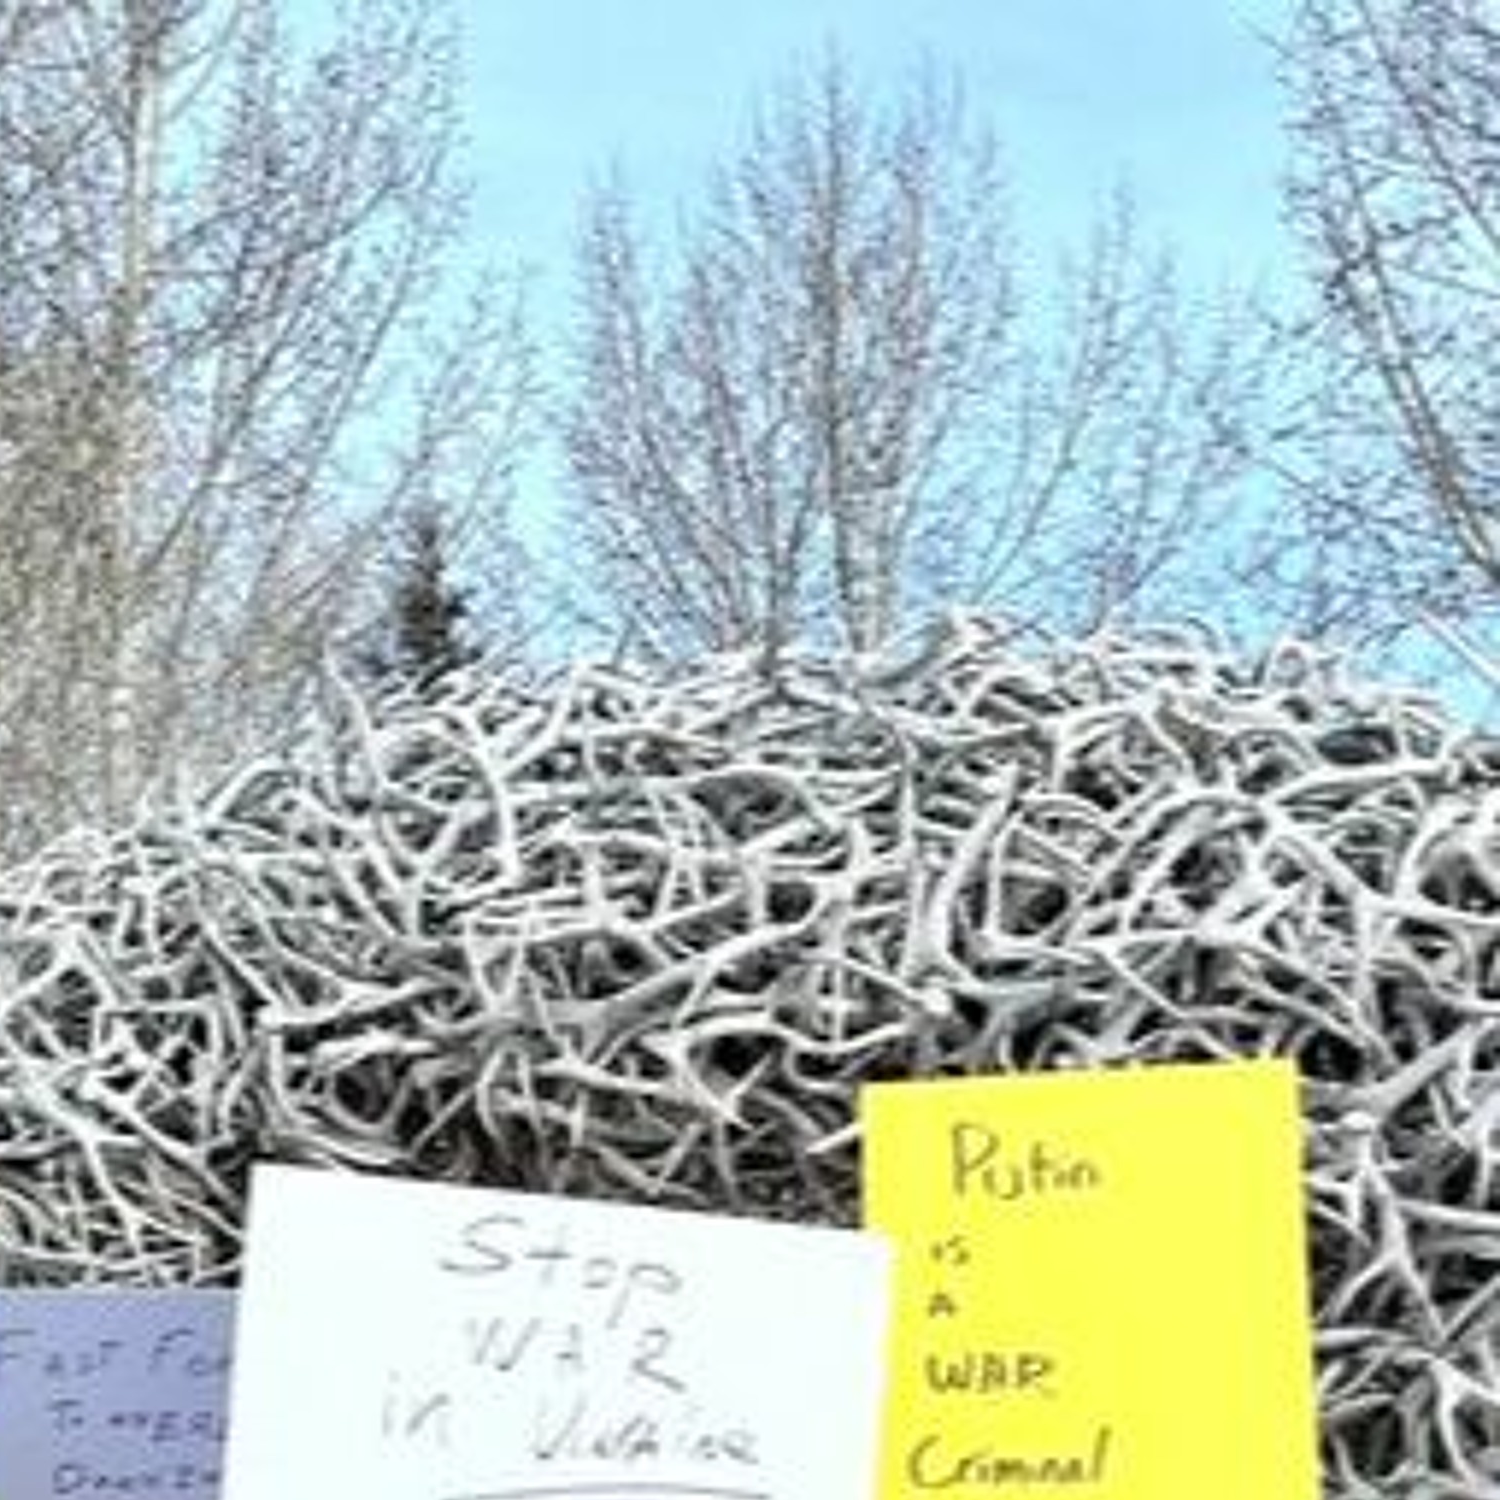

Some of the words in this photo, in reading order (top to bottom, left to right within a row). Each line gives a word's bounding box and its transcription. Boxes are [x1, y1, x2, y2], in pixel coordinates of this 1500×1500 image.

[952, 1120, 1100, 1200] Putin
[439, 1212, 684, 1330] Stop
[467, 1318, 687, 1393] WAR
[924, 1351, 1057, 1395] WAR
[908, 1426, 1112, 1488] Criminal
